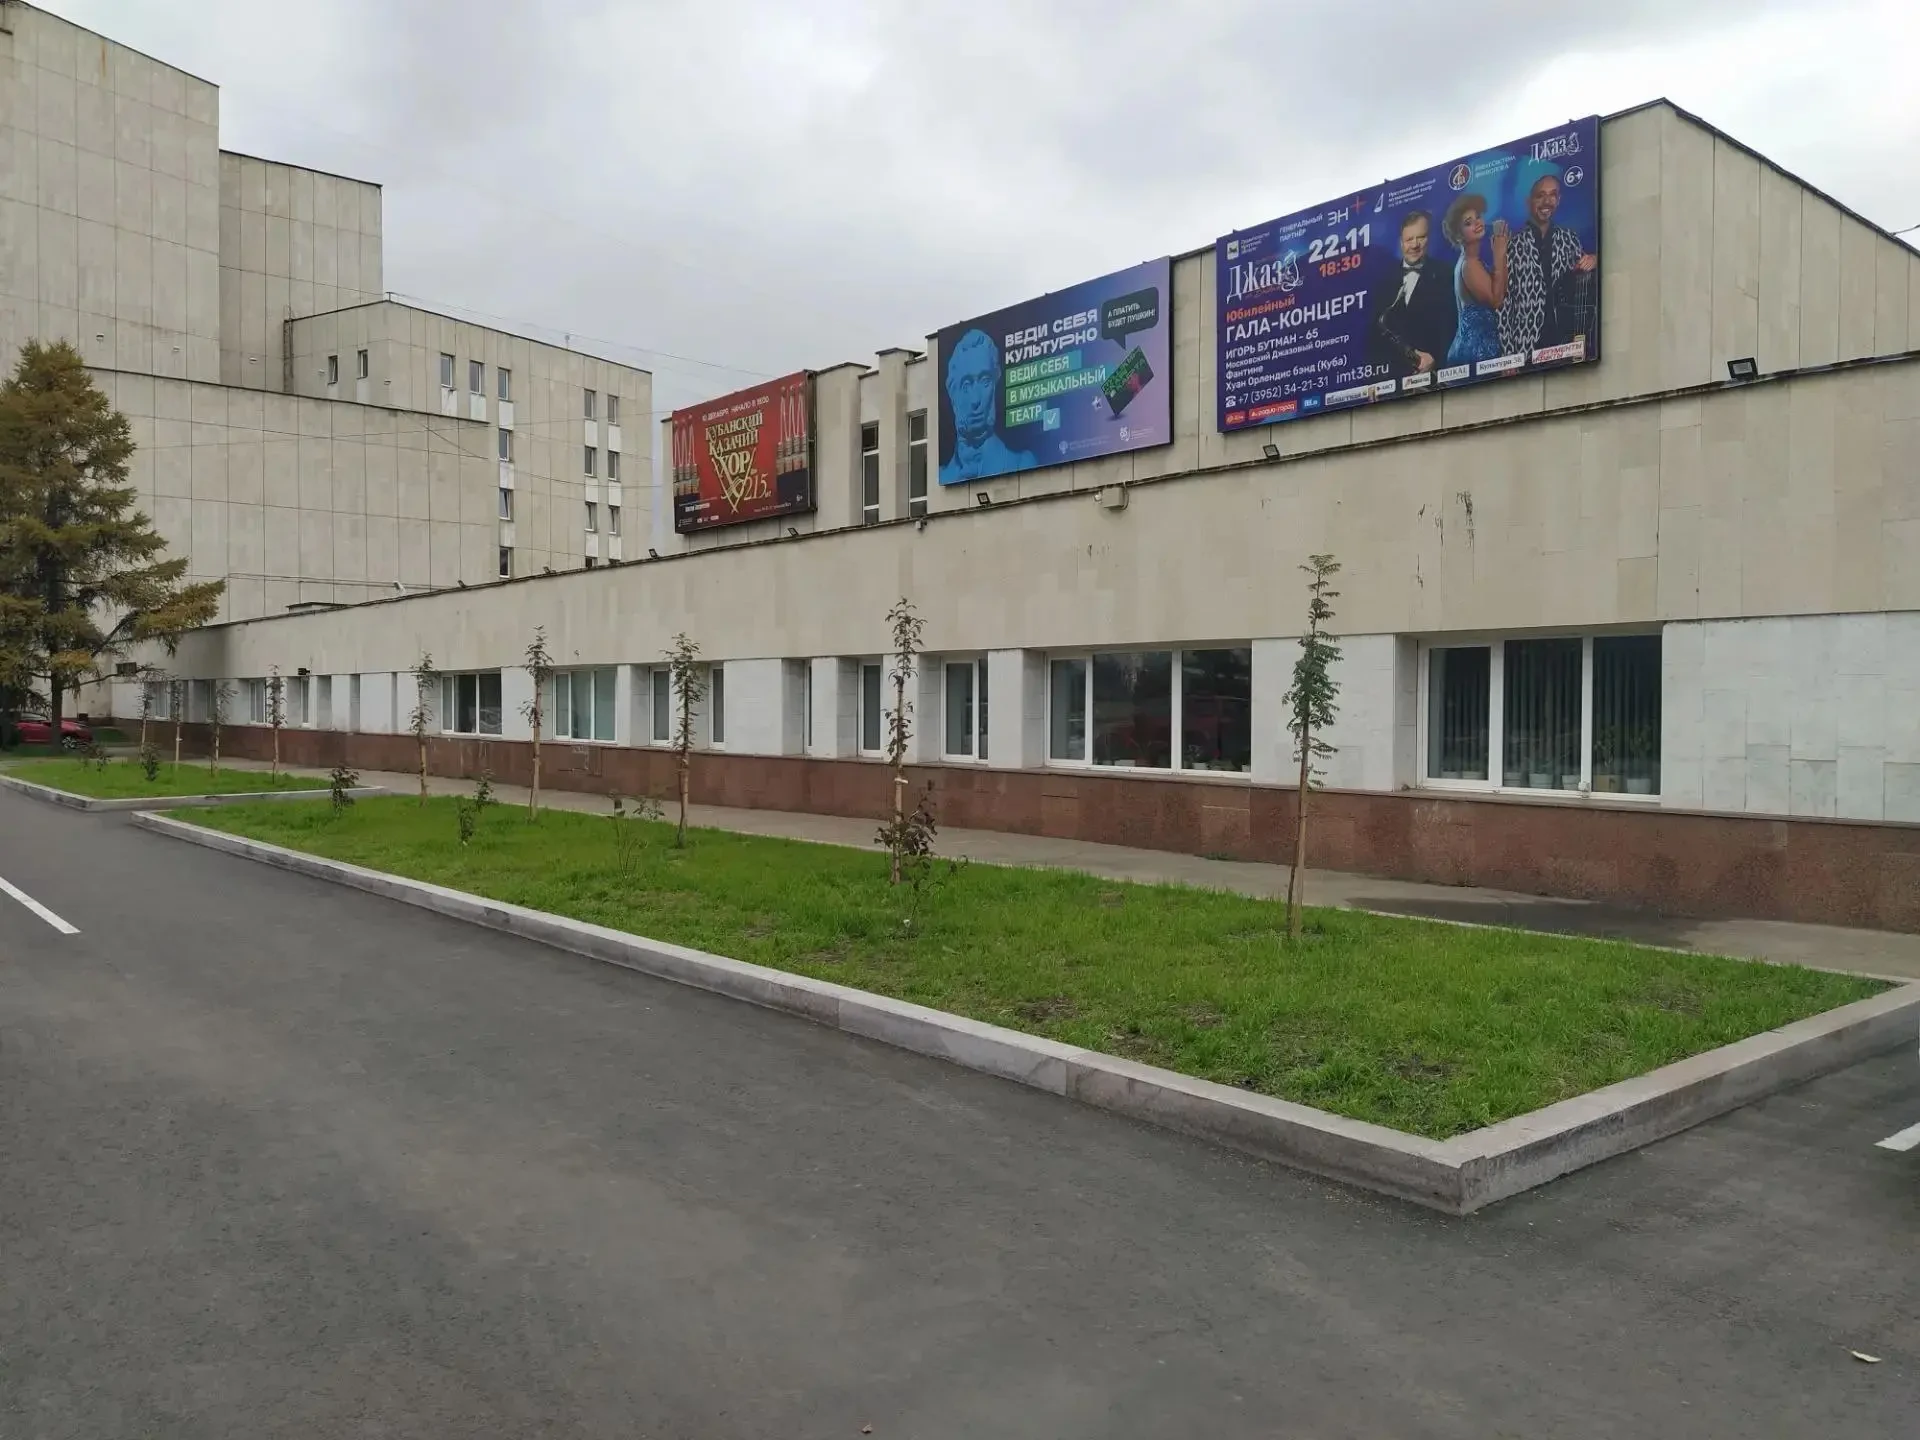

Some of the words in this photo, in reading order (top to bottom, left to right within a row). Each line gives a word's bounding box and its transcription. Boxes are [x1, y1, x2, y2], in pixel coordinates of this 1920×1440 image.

[1567, 171, 1583, 183] 6+
[1279, 213, 1323, 234] ГЕНЕРАЛЬНЫЙ
[1308, 223, 1370, 263] 22.11
[1319, 254, 1361, 277] 18:30
[1226, 260, 1284, 304] Джаз
[1107, 311, 1113, 319] А
[1113, 302, 1141, 316] ПЛАТИТЬ
[1108, 317, 1126, 329] БУДЕТ
[1127, 308, 1156, 324] ПУШКИН!
[1226, 294, 1296, 323] Юбилейный
[1226, 290, 1368, 343] ГАЛА-КОНЦЕРТ
[1005, 323, 1048, 348] ВЕДИ
[1052, 308, 1098, 333] СЕБЯ
[1005, 327, 1098, 365] КУЛЬТУРНО
[1225, 352, 1271, 369] Московский
[1272, 341, 1314, 360] Джазовый
[1315, 334, 1350, 349] Оркестр
[1226, 345, 1256, 360] ИГОРЬ
[1257, 333, 1297, 352] БУТМАН
[1305, 328, 1319, 340] 65
[1010, 365, 1038, 383] ВЕДИ
[1040, 356, 1070, 375] СЕБЯ
[1225, 380, 1246, 392] Хуан
[1248, 370, 1291, 387] Орлендис
[1292, 365, 1316, 377] бэнд
[1317, 354, 1347, 373] (Куба)
[1226, 365, 1263, 379] Фантине
[1336, 363, 1390, 384] imt38.ru
[1479, 359, 1512, 371] Культура
[1010, 388, 1017, 403] В
[1019, 365, 1106, 400] МУЗЫКАЛЬНЫЙ
[1238, 393, 1249, 405] +7
[1251, 385, 1282, 404] (3952)
[1284, 376, 1329, 396] 34-21-31
[705, 409, 763, 442] КУБАНСКИЙ
[1010, 405, 1042, 424] ТЕАТР
[709, 429, 759, 456] КАЗАЧИЙ
[744, 473, 769, 501] 215
